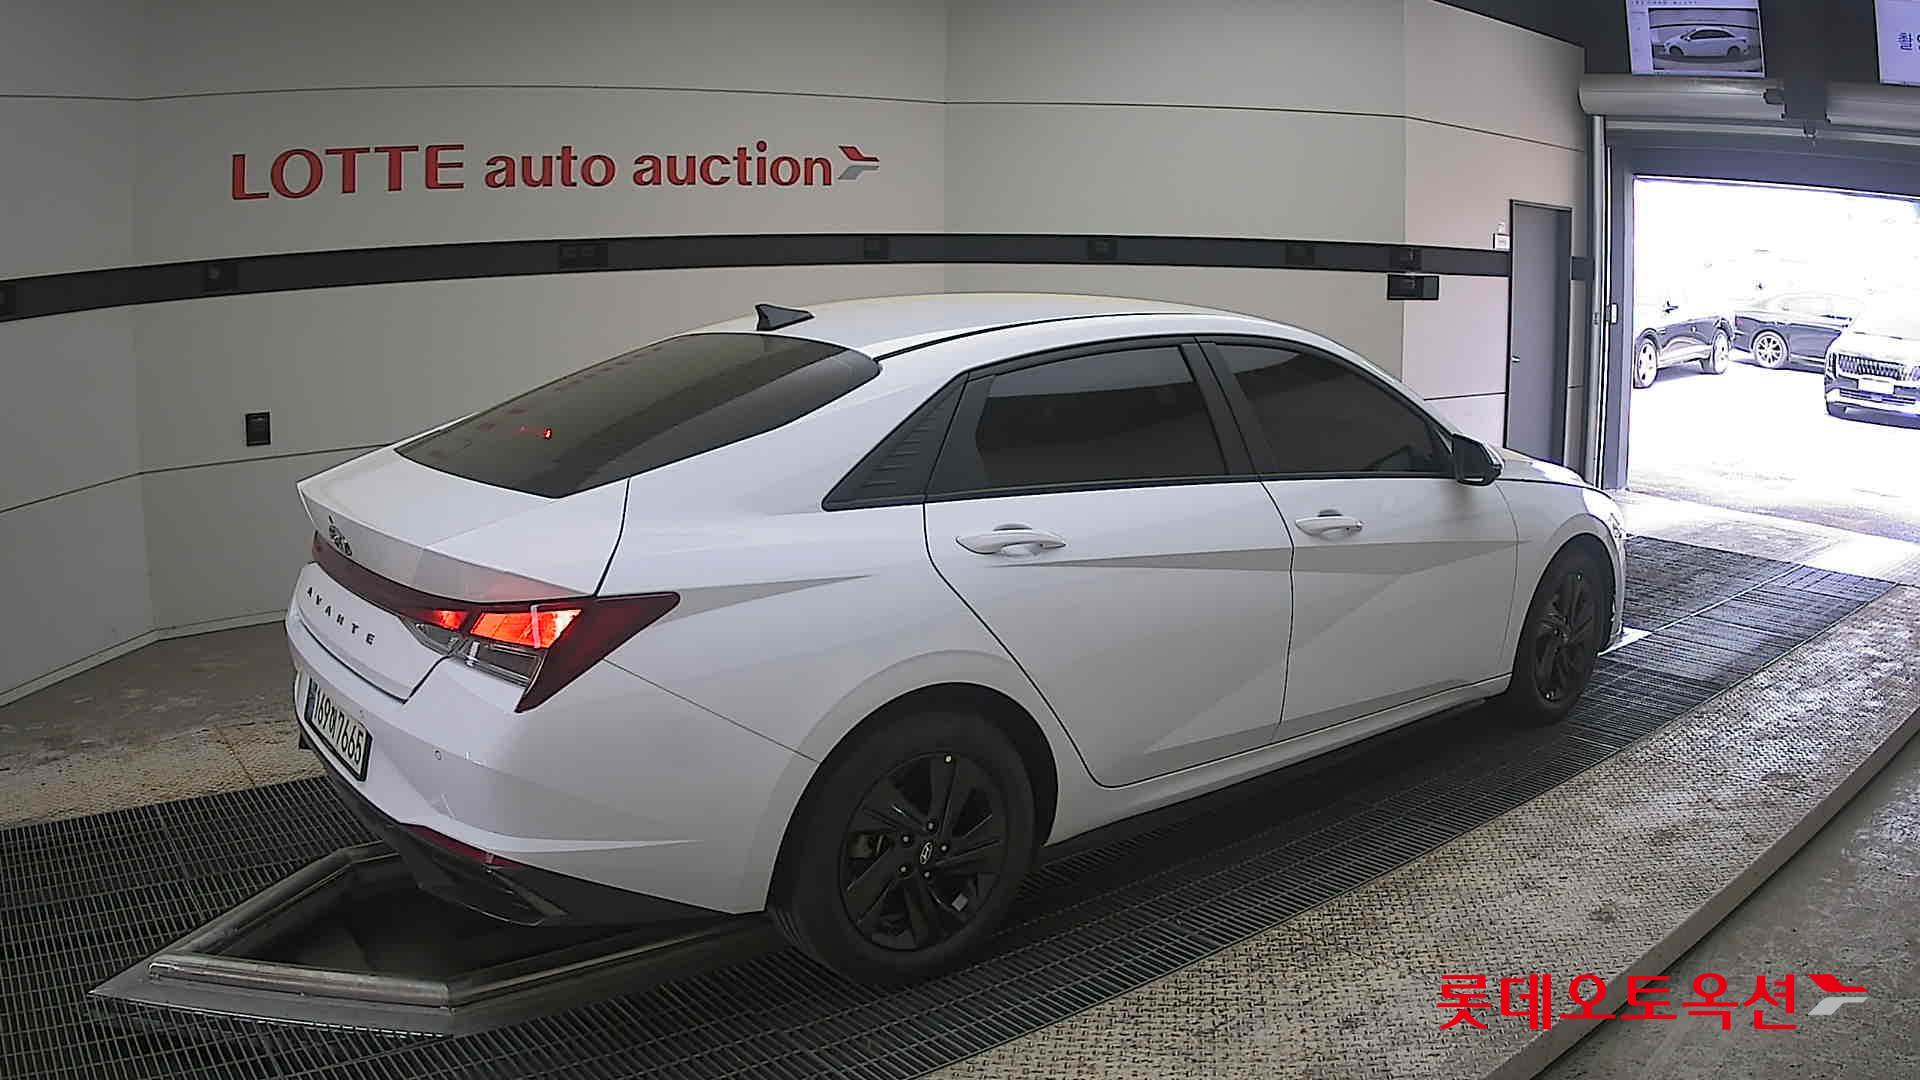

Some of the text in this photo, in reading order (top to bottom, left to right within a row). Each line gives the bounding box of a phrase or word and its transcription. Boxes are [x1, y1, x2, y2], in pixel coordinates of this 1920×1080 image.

[231, 141, 833, 200] LOTTE auto auction
[307, 586, 376, 645] AVANTE
